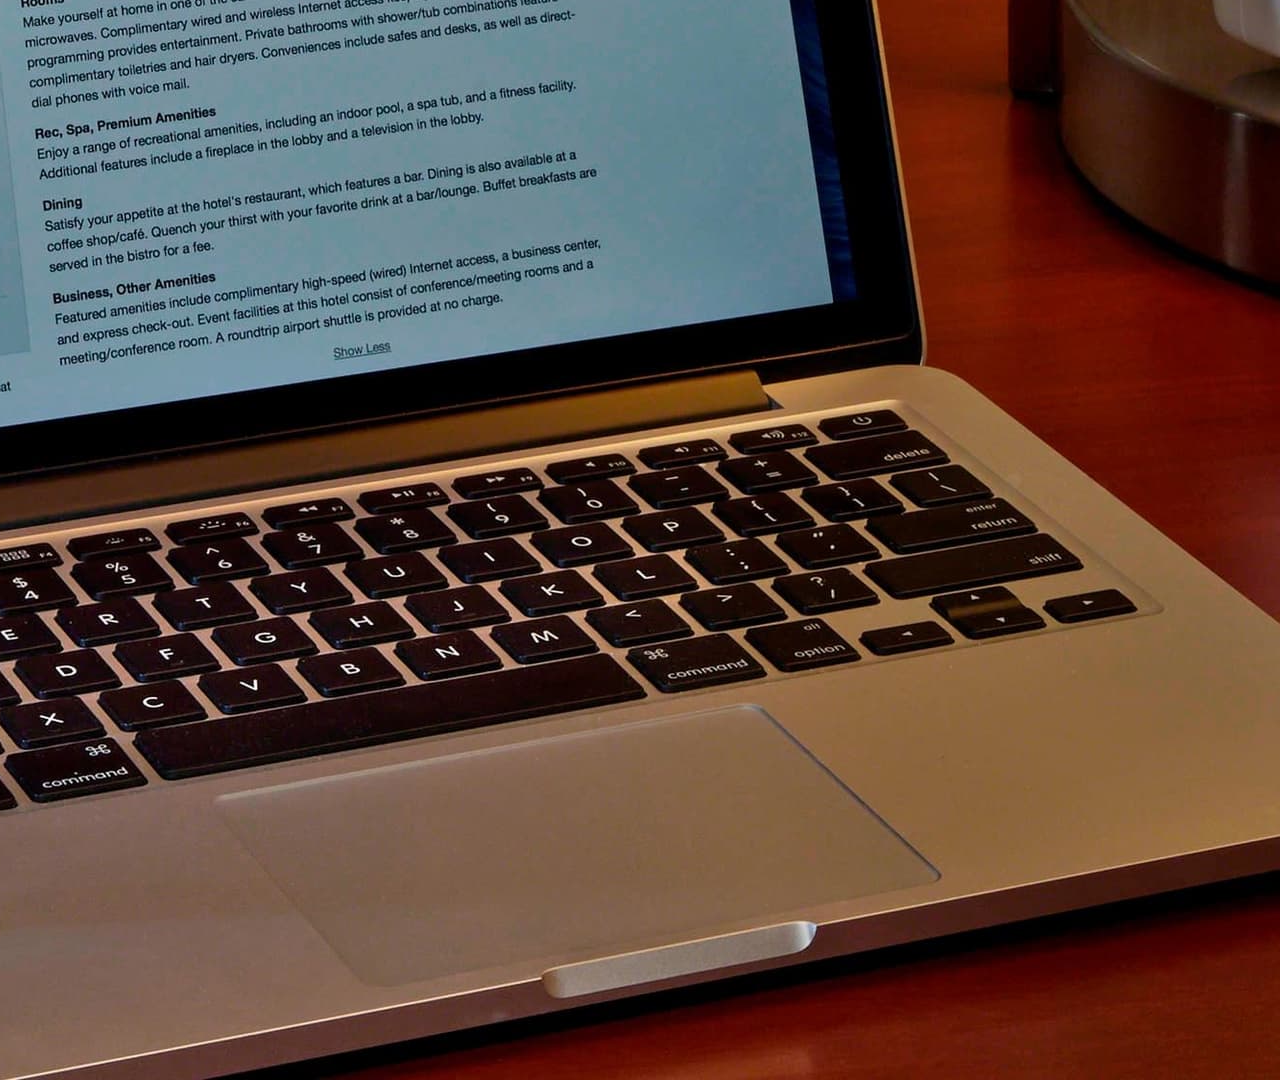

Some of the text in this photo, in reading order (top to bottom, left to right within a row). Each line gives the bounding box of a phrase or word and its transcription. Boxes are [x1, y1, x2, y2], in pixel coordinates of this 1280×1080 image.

[34, 106, 216, 140] Rec, Spa, Premium Amenities
[42, 196, 83, 212] Dining
[52, 272, 216, 304] Business, Other Amenities
[883, 448, 931, 462] delete
[970, 517, 1018, 530] return
[1028, 553, 1062, 565] shift
[794, 644, 846, 658] option
[667, 659, 749, 680] command
[42, 766, 130, 789] command
